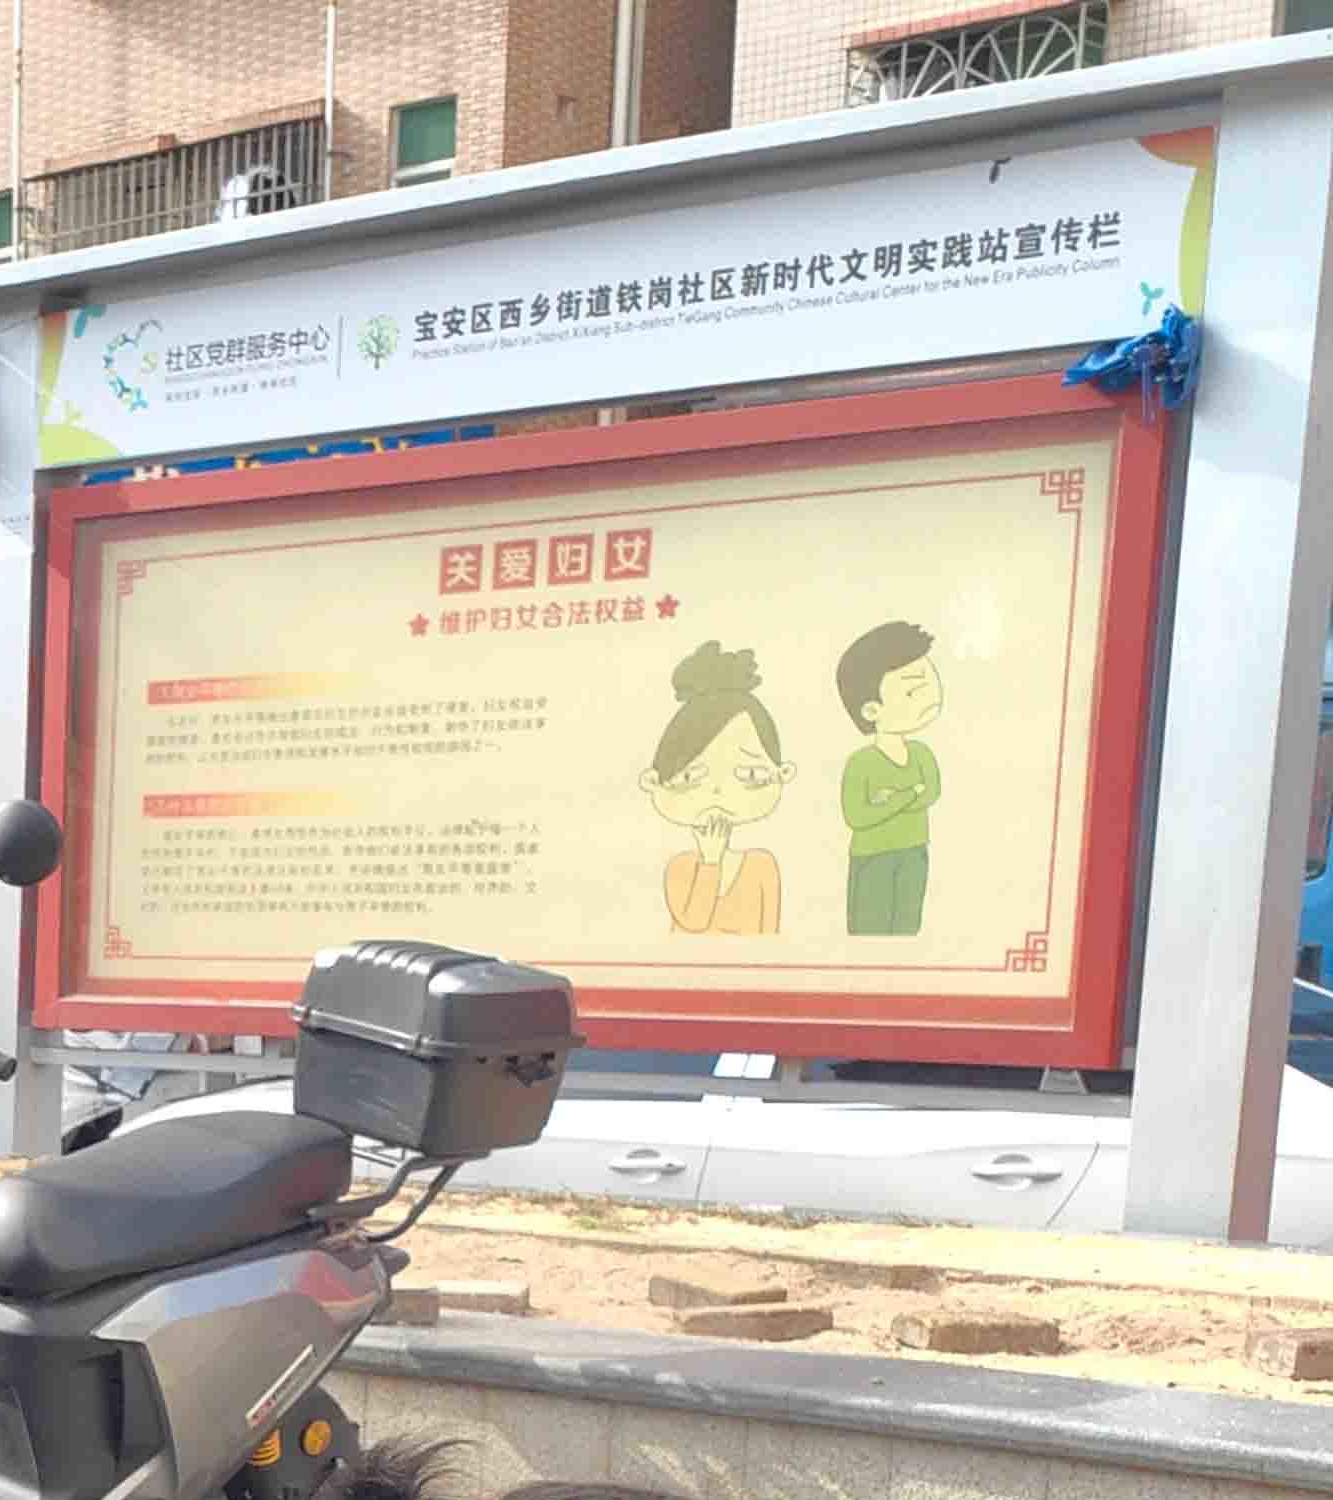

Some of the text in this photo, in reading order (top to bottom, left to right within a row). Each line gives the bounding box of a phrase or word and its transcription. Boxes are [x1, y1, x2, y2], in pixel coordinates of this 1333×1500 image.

[414, 211, 1121, 342] 宝安区西乡街道铁岗社区新时代文明实践站宣传栏
[789, 294, 833, 311] Chinese
[836, 287, 879, 304] Cultural
[942, 275, 960, 290] the
[964, 271, 990, 287] New
[993, 269, 1013, 284] Era
[1016, 263, 1070, 281] Publicity
[1072, 256, 1121, 273] Column
[166, 324, 330, 372] 社区党群服务中心
[442, 532, 650, 590] 关爱妇女
[439, 596, 646, 636] 维护妇女合法权益
